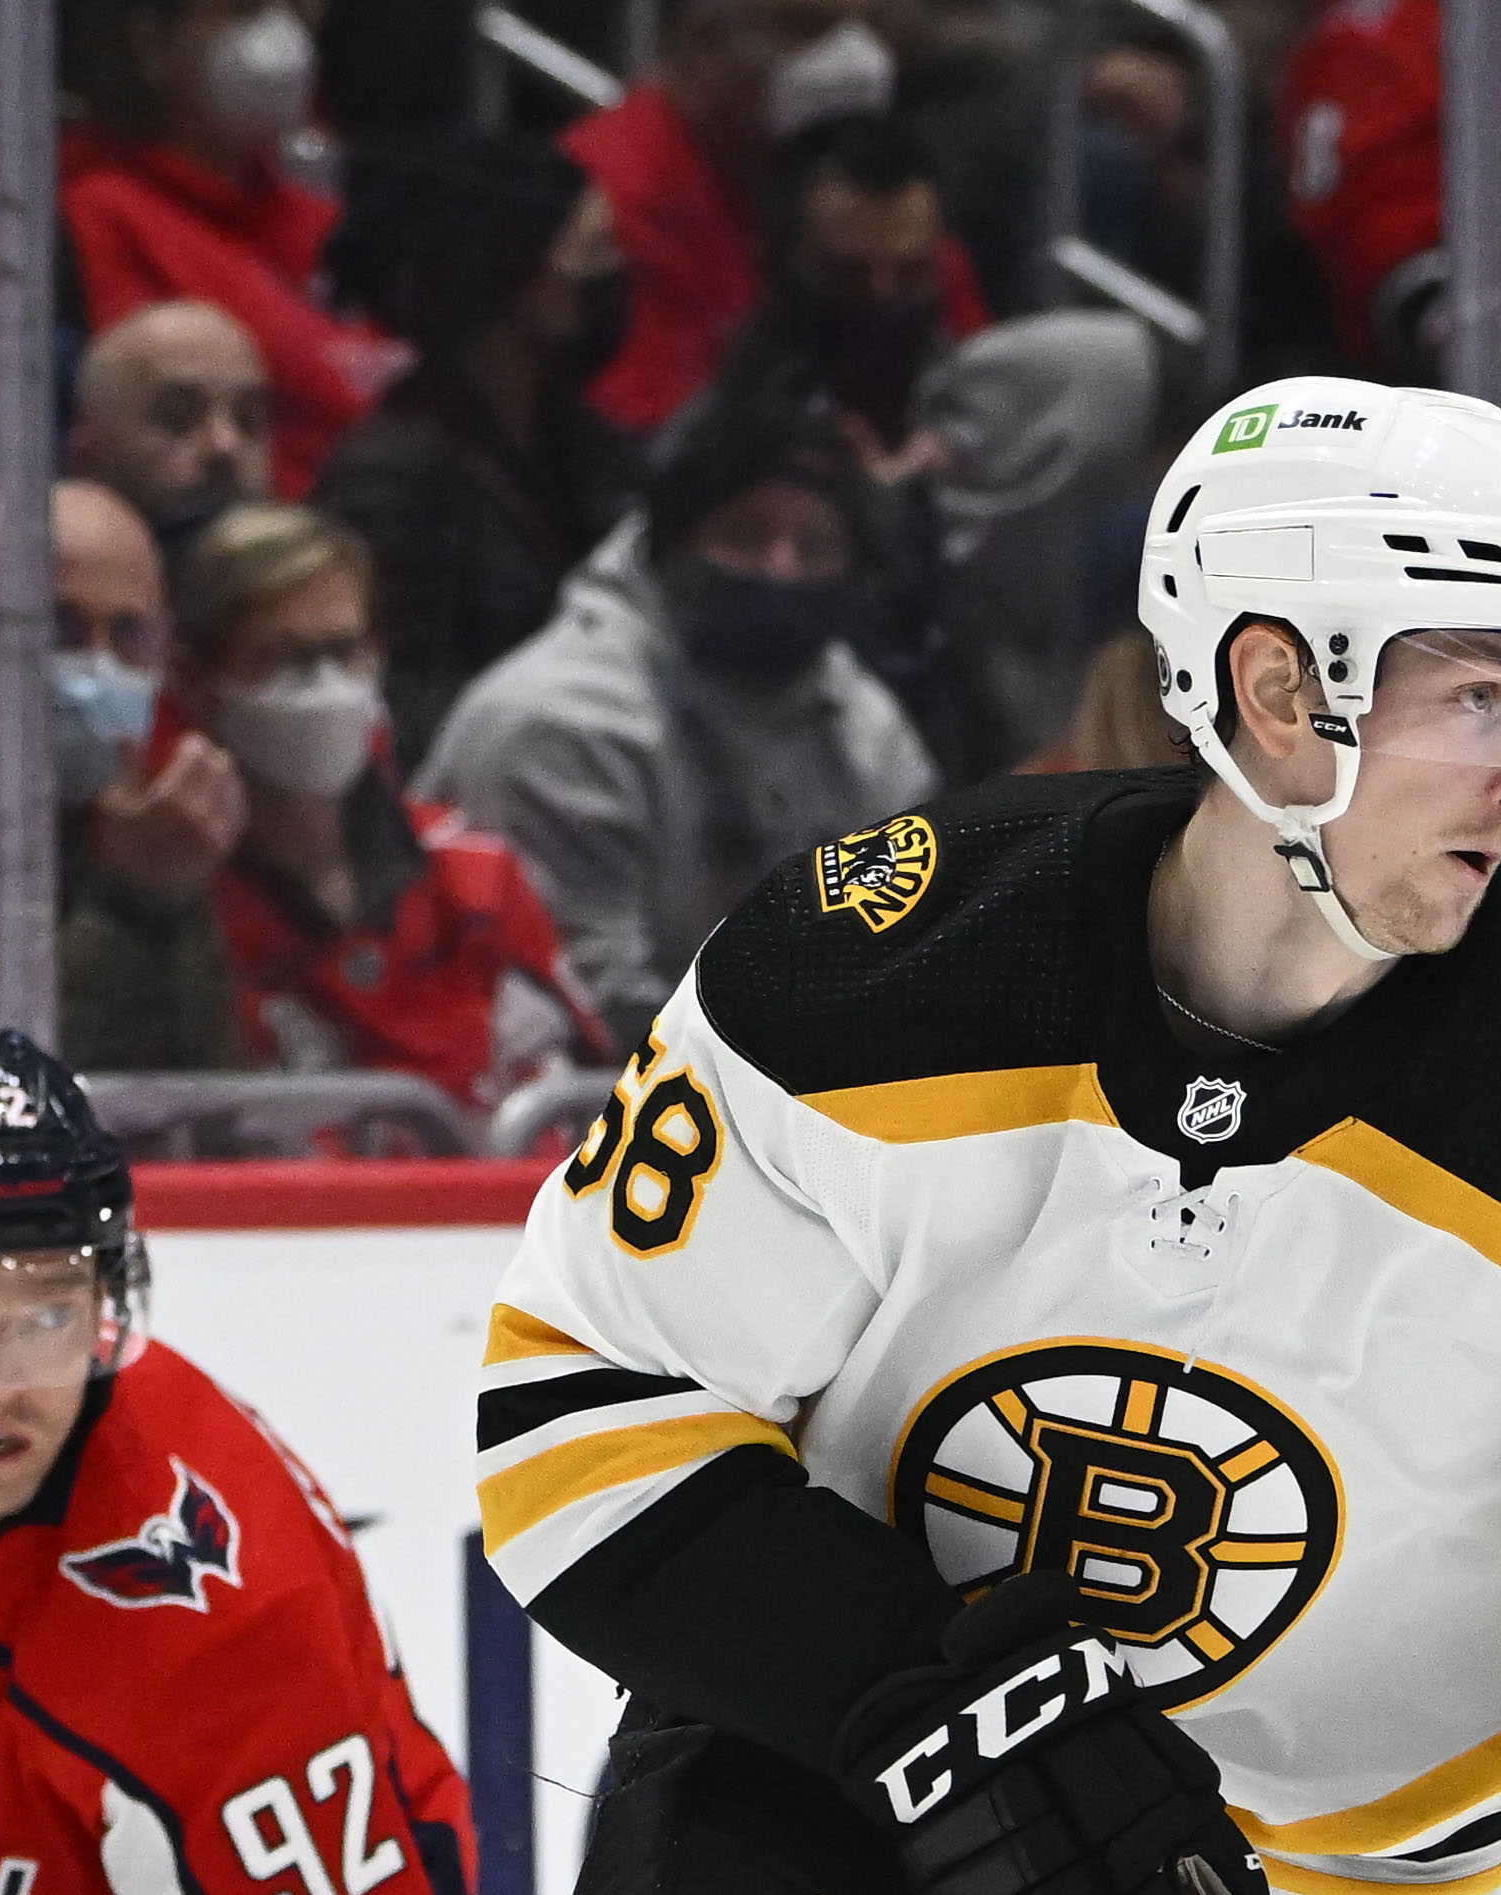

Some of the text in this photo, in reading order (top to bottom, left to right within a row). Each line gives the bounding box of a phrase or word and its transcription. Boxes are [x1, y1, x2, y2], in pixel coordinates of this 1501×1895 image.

[1227, 411, 1268, 443] TD
[1313, 720, 1348, 733] CCM
[859, 818, 929, 927] OSTON
[1190, 1096, 1232, 1128] NHL
[874, 1637, 1139, 1824] CCM
